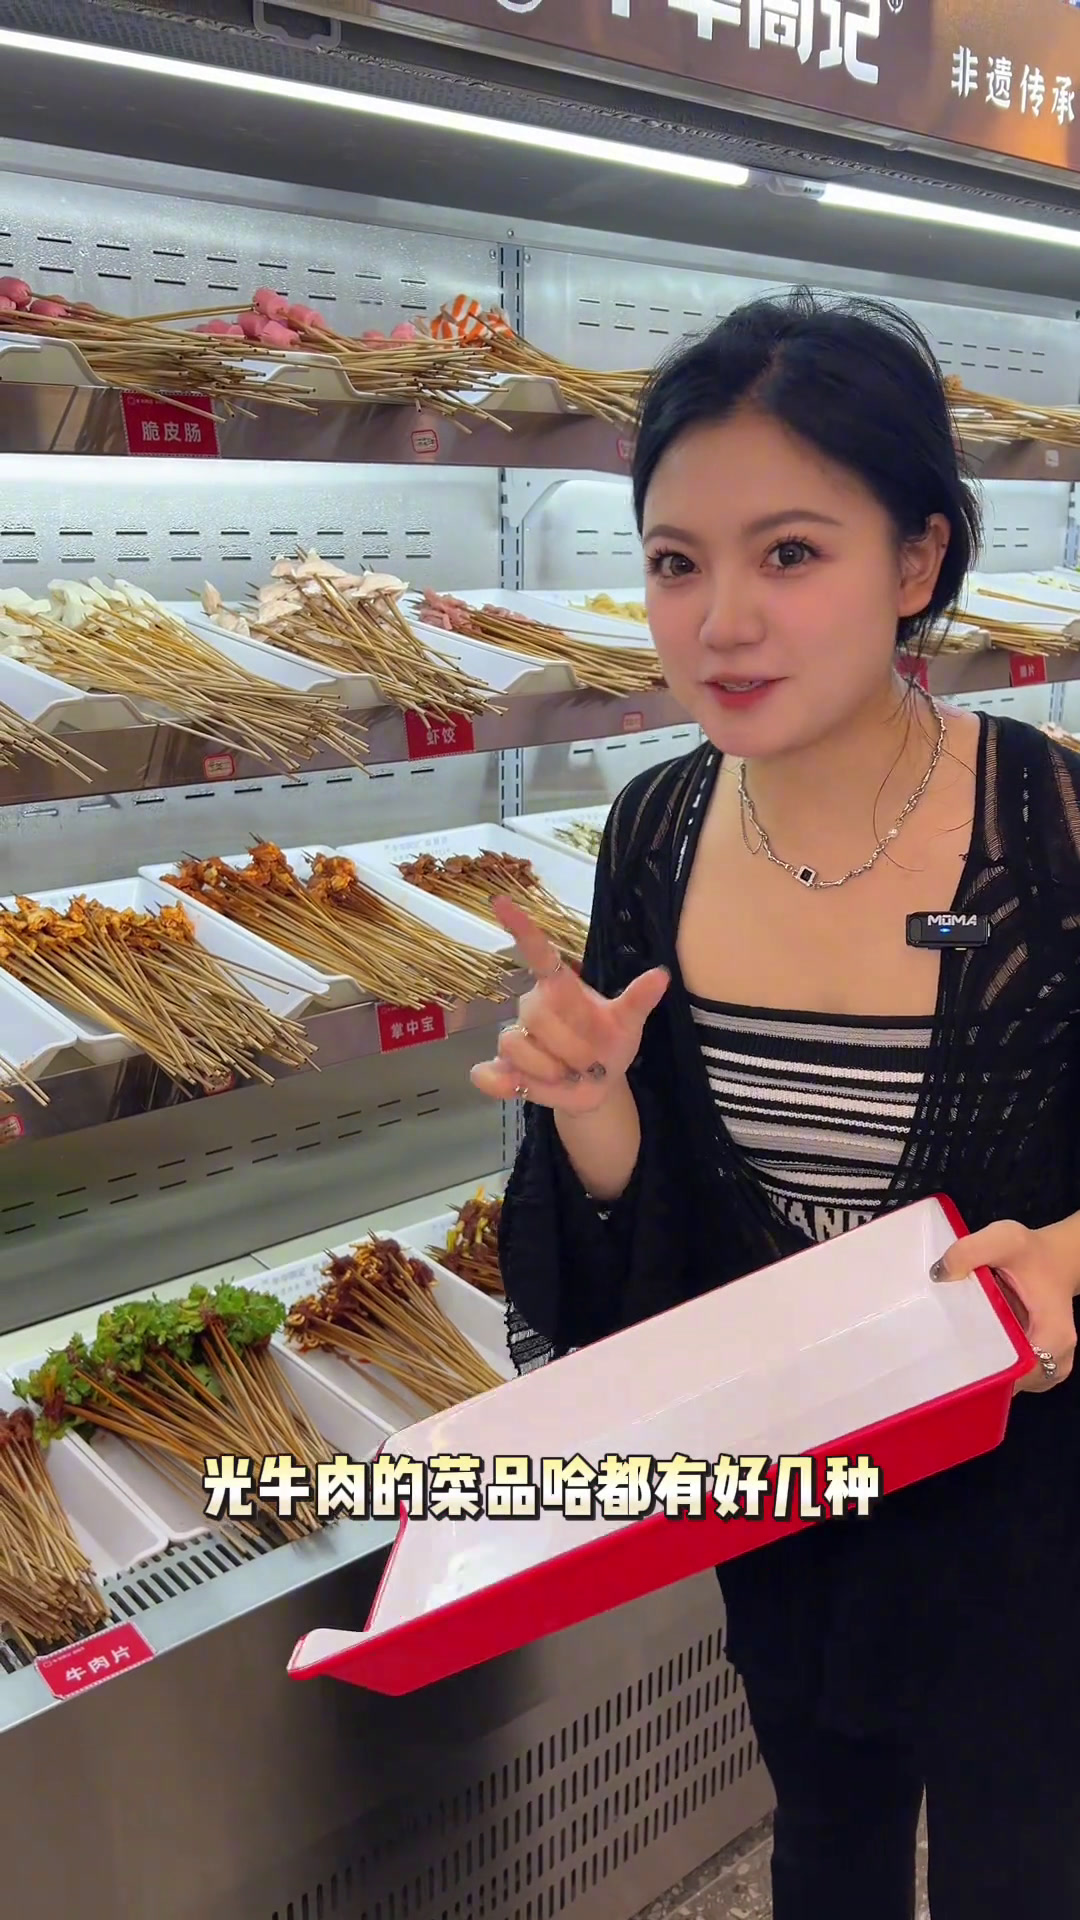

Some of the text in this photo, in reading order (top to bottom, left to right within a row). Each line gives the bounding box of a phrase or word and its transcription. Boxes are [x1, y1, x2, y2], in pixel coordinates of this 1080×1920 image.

[950, 44, 1076, 126] 非遗传承
[141, 420, 202, 443] 脆皮肠
[426, 727, 457, 746] 虾饺
[390, 1015, 435, 1040] 掌中宝
[65, 1645, 131, 1682] 牛肉片
